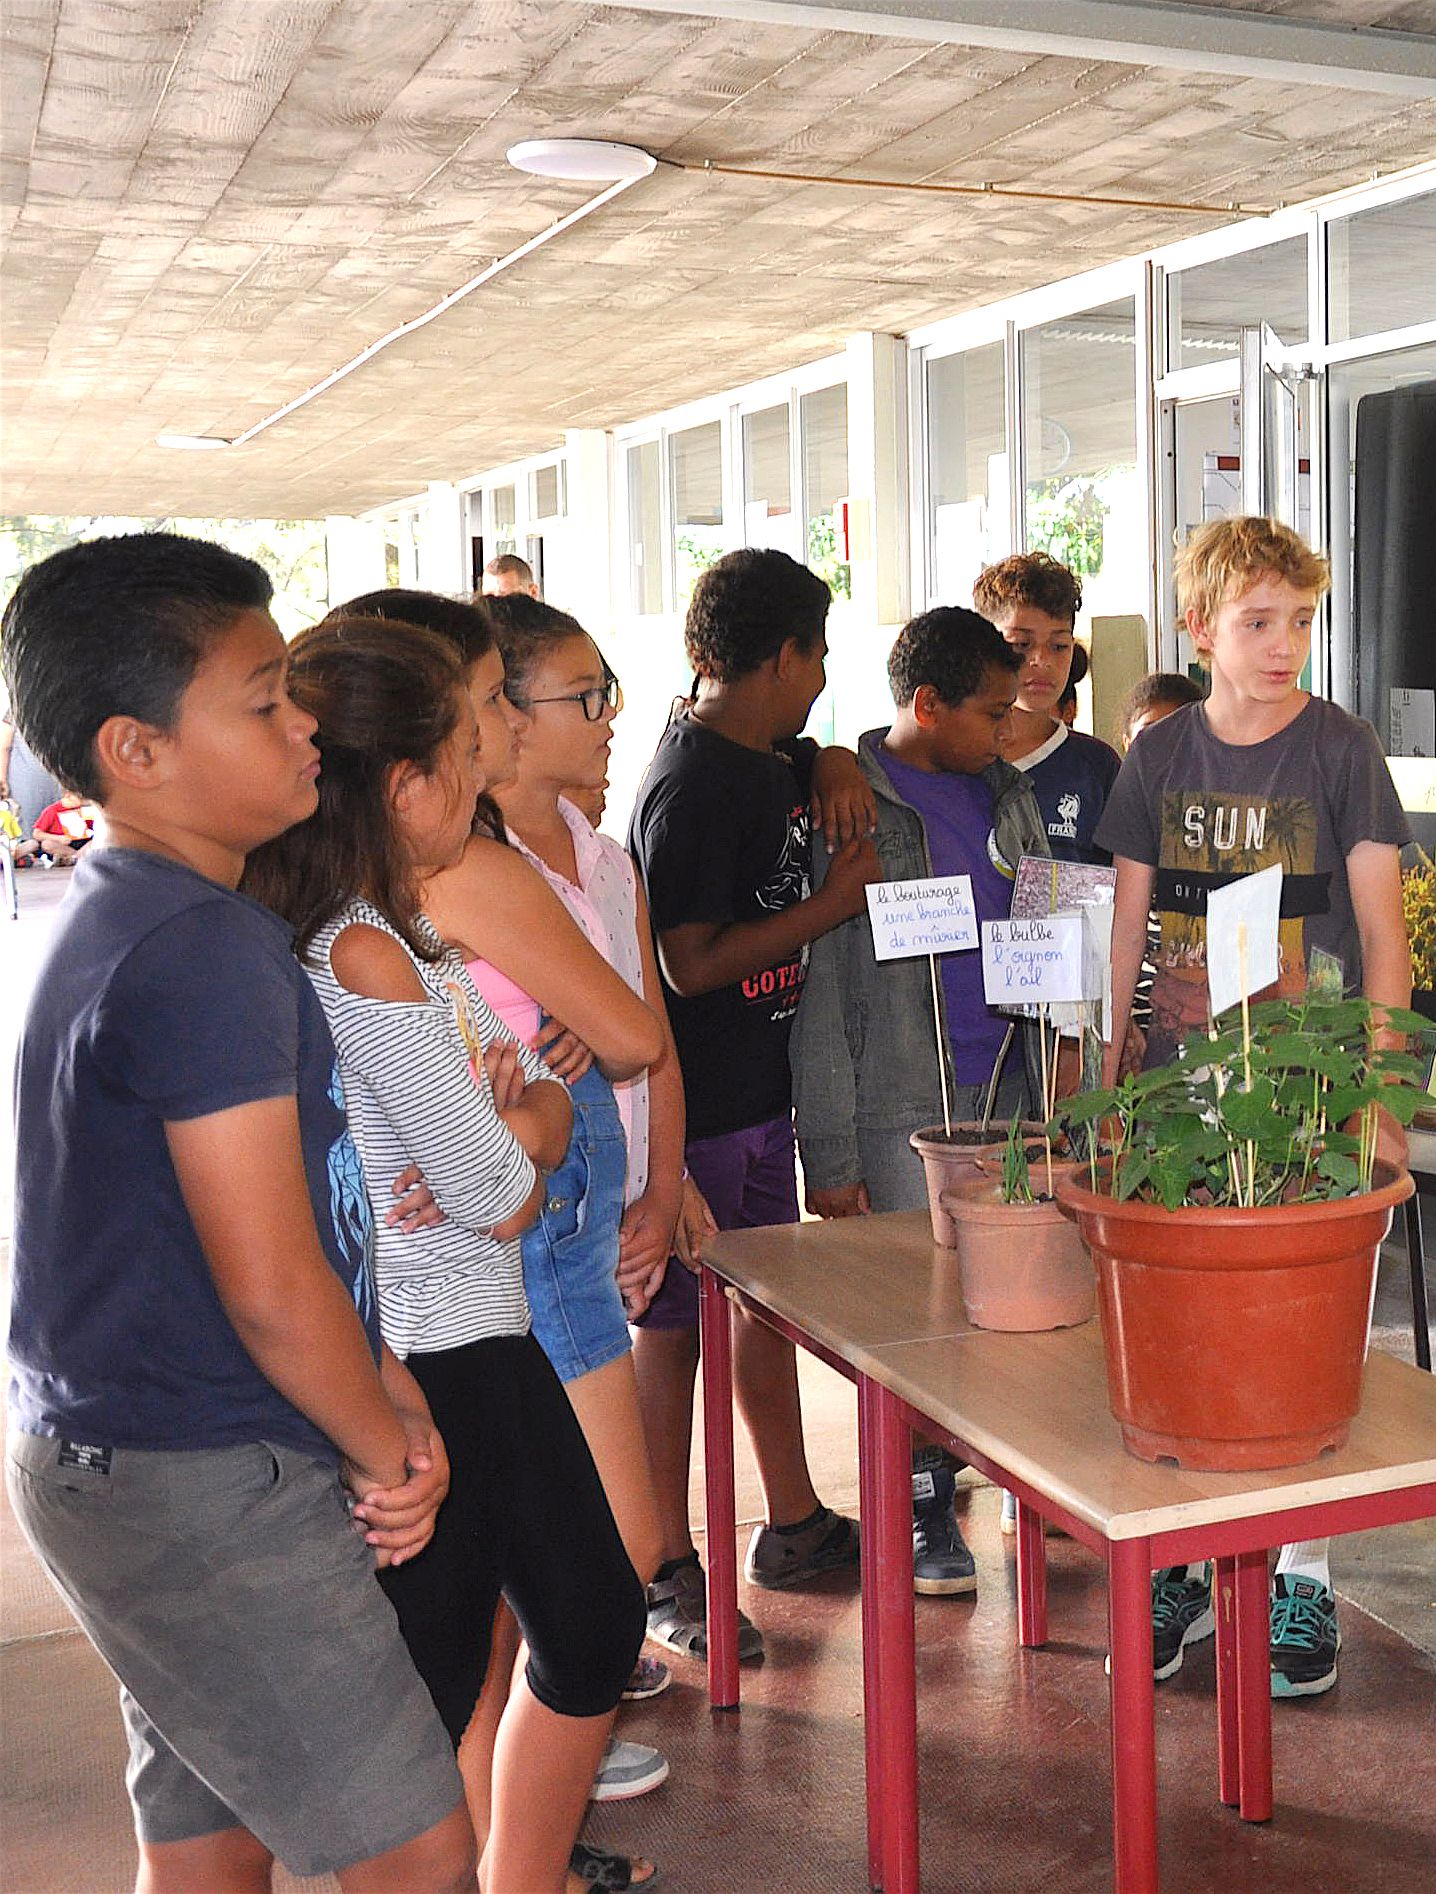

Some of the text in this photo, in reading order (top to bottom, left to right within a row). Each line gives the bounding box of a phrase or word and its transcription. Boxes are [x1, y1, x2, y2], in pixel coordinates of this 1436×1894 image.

[1183, 805, 1268, 851] SUN
[876, 884, 962, 906] le bouturage
[882, 901, 972, 926] une branche
[889, 930, 906, 949] de
[990, 921, 1055, 943] le bulbe
[1005, 966, 1042, 987] l'ail
